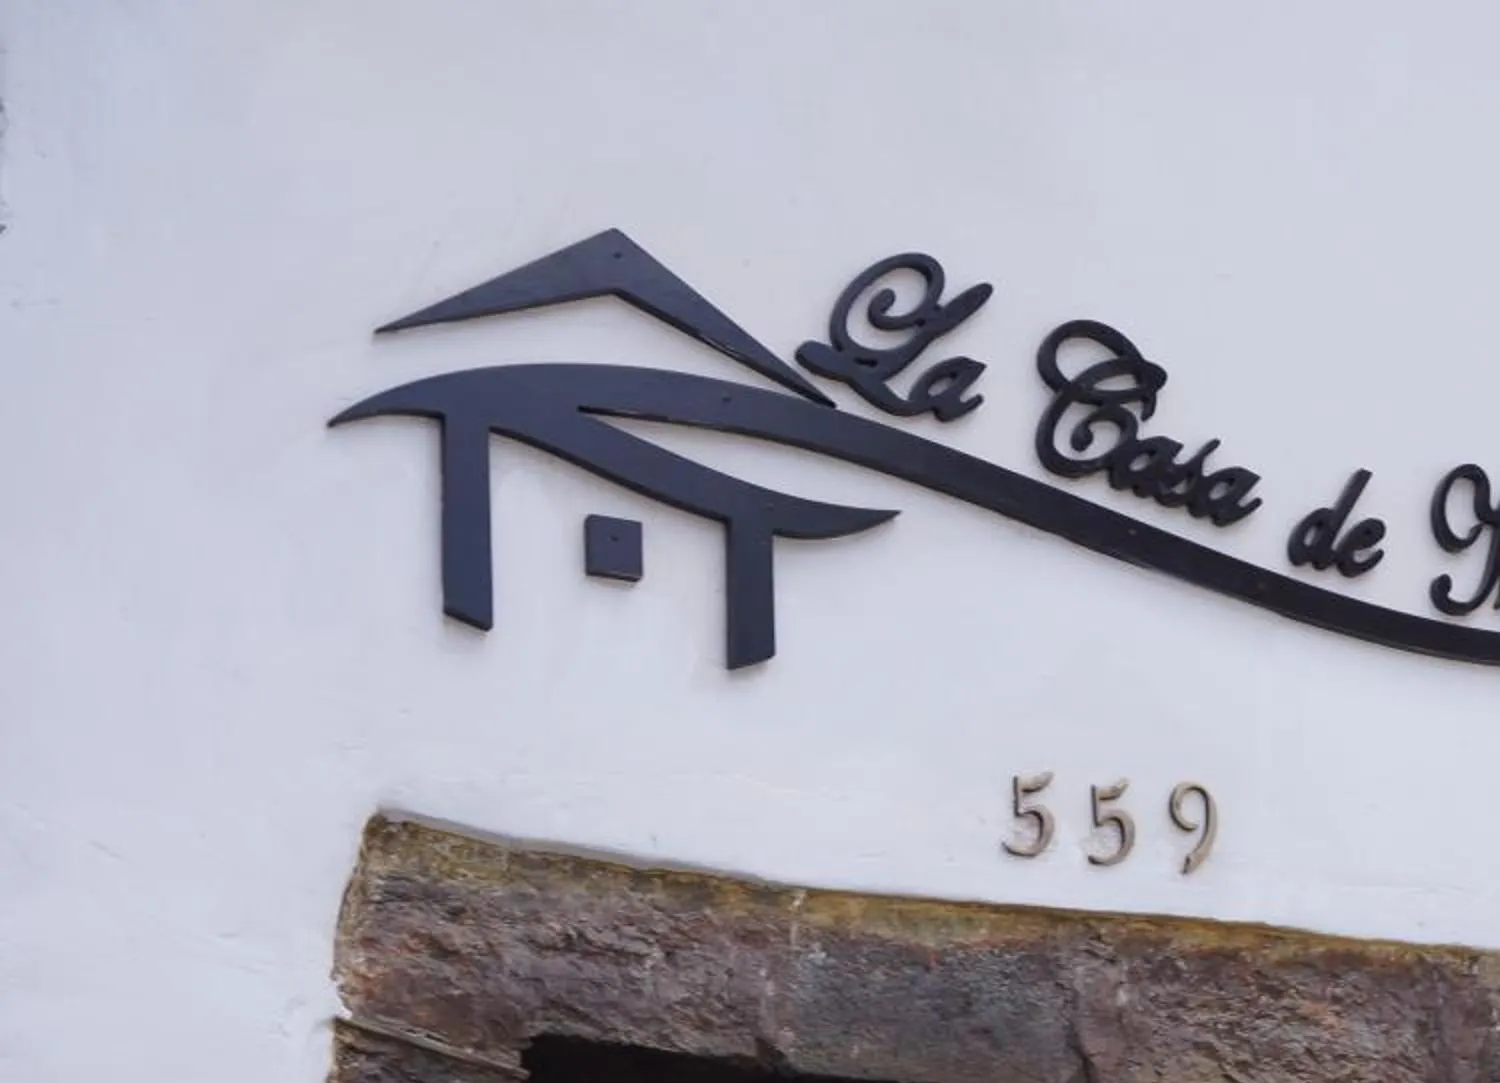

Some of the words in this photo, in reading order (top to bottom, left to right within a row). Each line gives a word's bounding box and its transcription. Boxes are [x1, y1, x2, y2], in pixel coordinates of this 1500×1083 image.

[793, 251, 994, 422] La
[1034, 318, 1262, 528] Casa
[1286, 468, 1386, 577] de
[1001, 770, 1217, 875] 559
